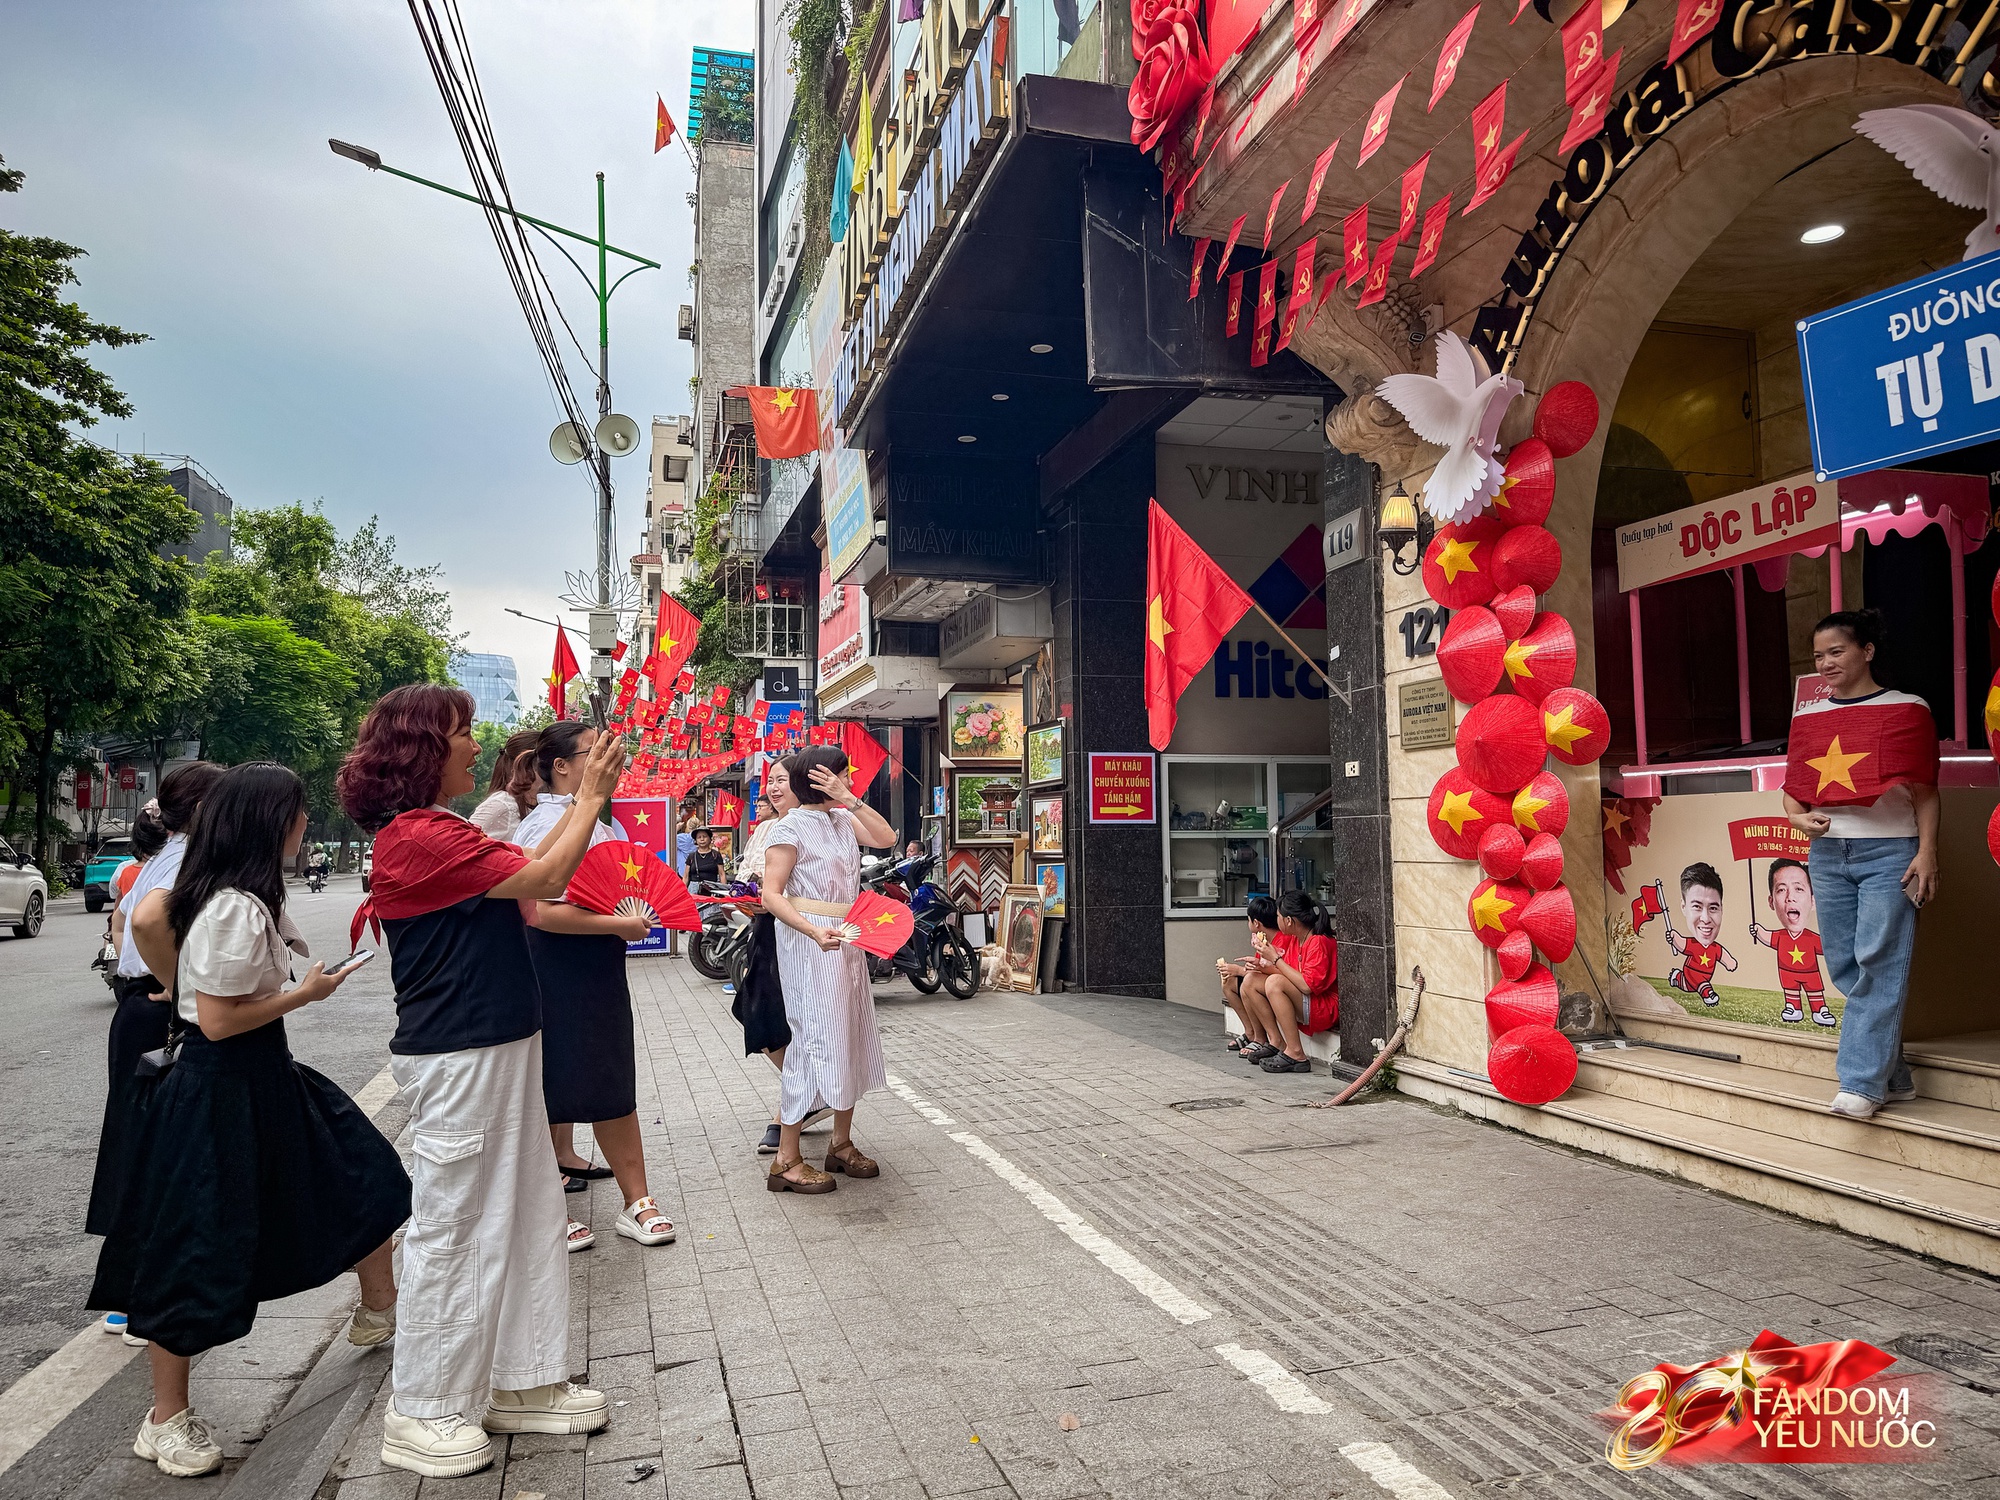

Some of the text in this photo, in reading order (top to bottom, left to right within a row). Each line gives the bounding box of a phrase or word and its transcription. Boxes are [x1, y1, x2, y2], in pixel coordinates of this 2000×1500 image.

[941, 13, 995, 207] MAY
[1468, 60, 1695, 376] Aurora
[1887, 280, 2000, 342] ĐƯỜNG
[1876, 341, 1945, 433] TỰ
[1186, 462, 1318, 506] VINH
[899, 521, 956, 554] MÁY
[1329, 523, 1353, 557] 119
[1679, 485, 1817, 558] ĐỘC LẬP
[1399, 607, 1446, 658] 121
[1403, 706, 1422, 717] AURORA
[1434, 702, 1447, 712] NAM
[1104, 759, 1142, 771] MÁY KHÂU
[1125, 773, 1150, 788] XUỐNG
[644, 936, 661, 945] PHÚC
